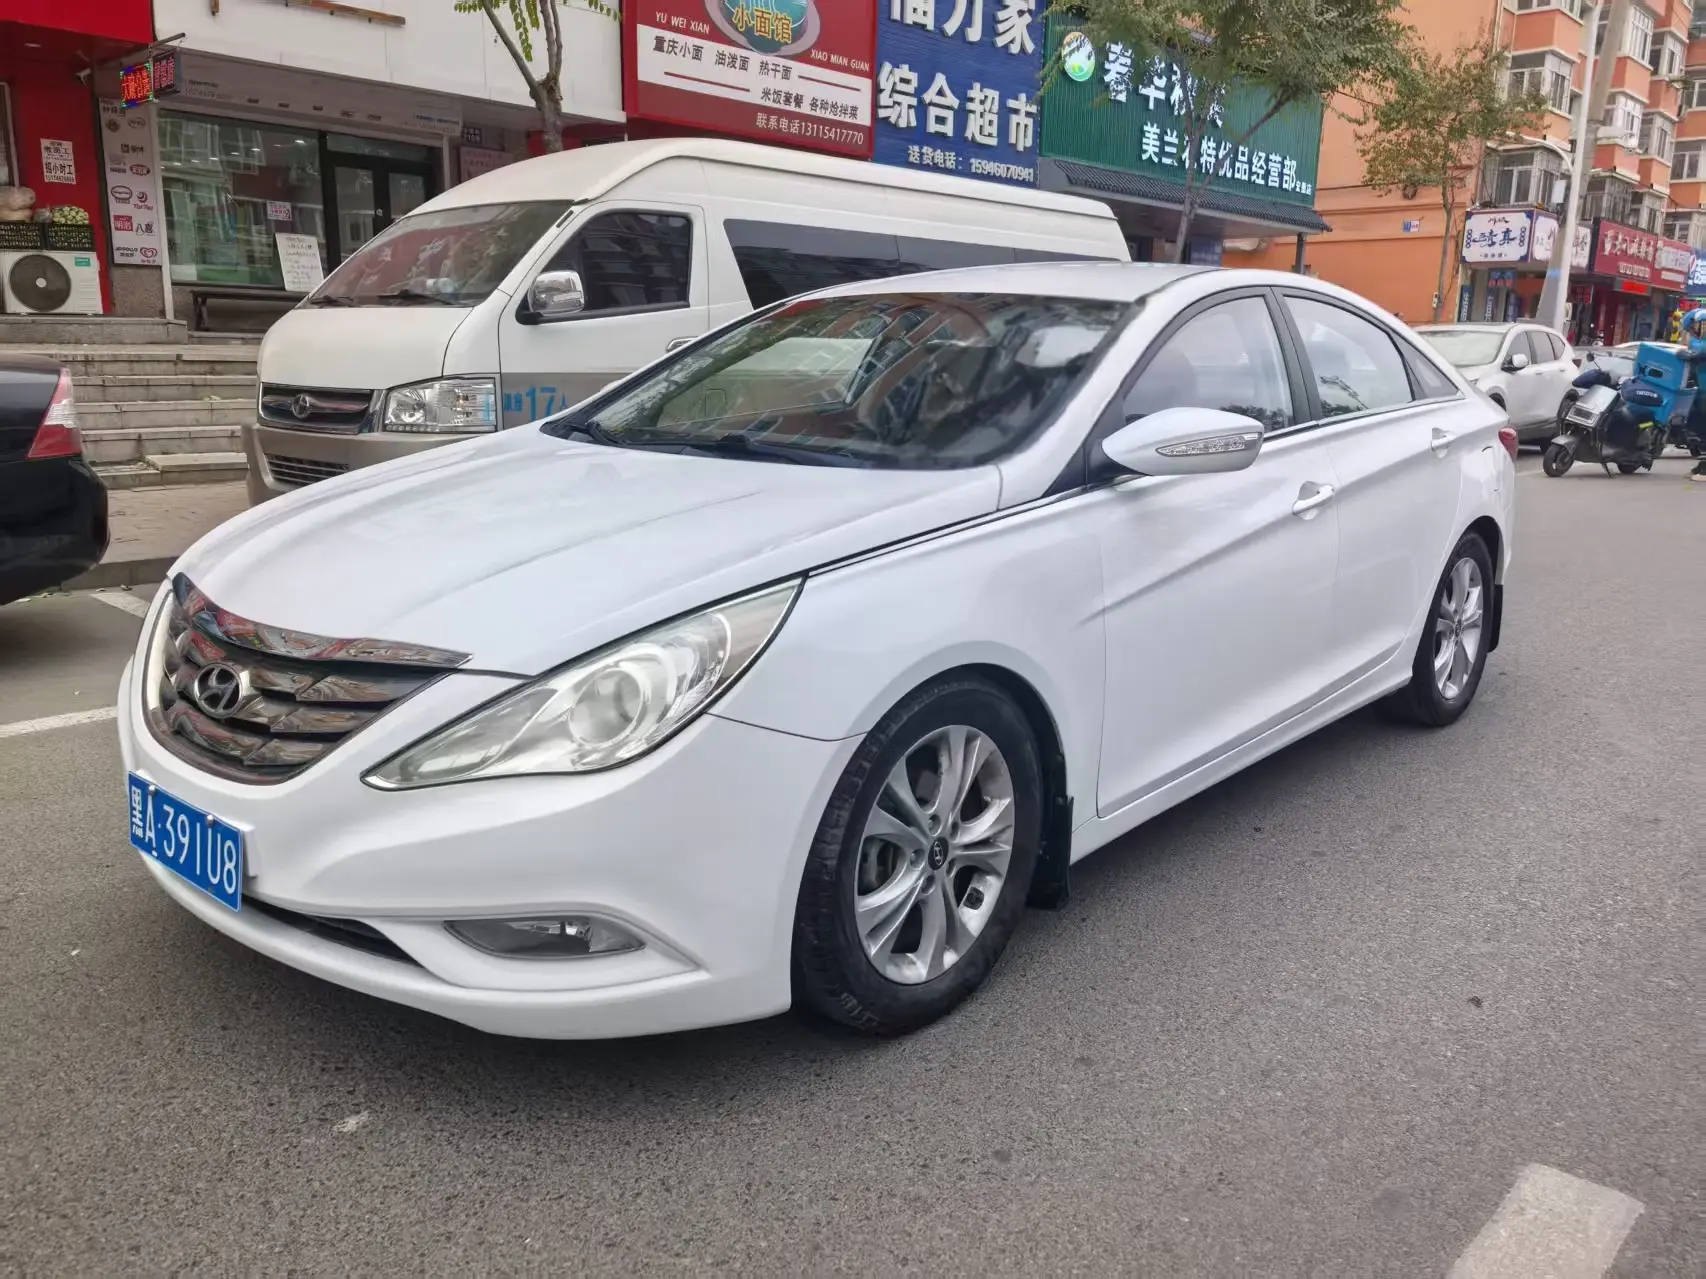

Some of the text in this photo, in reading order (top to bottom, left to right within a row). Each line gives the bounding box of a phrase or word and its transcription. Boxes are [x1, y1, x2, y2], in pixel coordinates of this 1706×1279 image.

[655, 12, 710, 34] YU WEI XIAN
[732, 3, 793, 44] 小面馆
[652, 35, 792, 81] 重庆小面 油泼面 热干面
[810, 49, 869, 72] XIAO MIAN GUAN
[761, 86, 804, 109] 米饭套餐
[877, 61, 1037, 152] 综合超市
